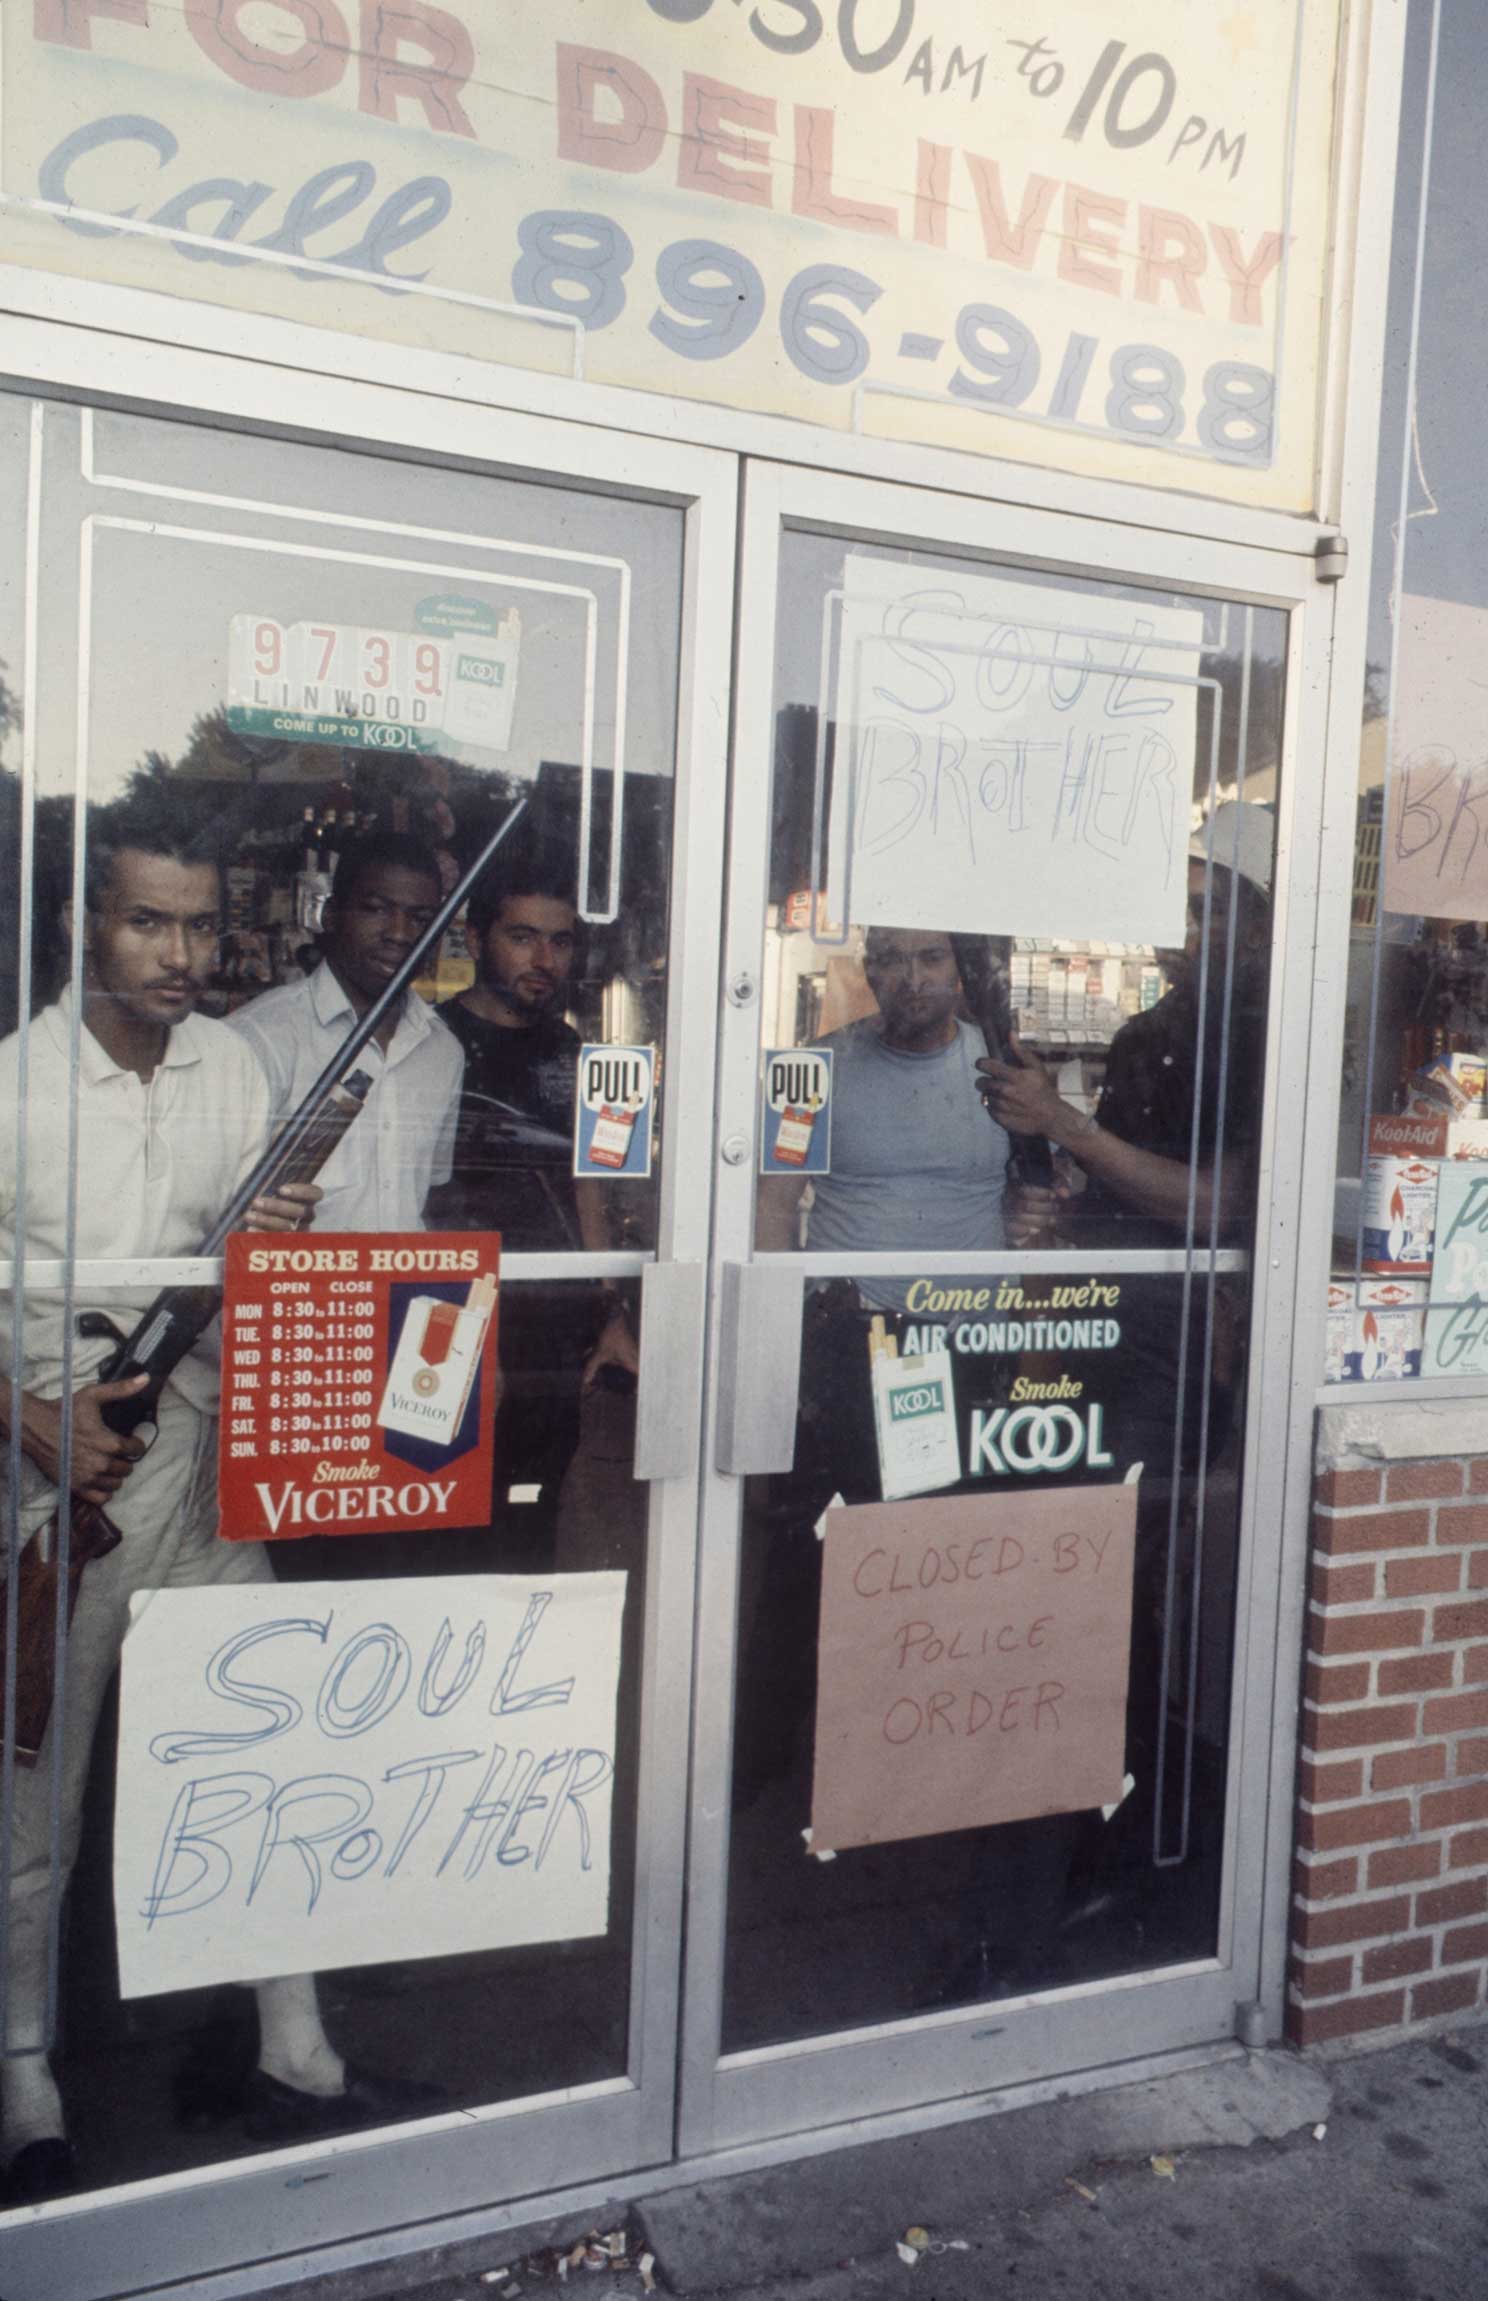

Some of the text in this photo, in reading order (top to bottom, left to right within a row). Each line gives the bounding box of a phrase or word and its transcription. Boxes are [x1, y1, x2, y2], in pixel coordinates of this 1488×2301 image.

[902, 35, 988, 103] AM
[1006, 35, 1065, 99] to
[1062, 39, 1177, 149] 10
[1168, 115, 1248, 182] PM
[555, 41, 1297, 327] DELIVERY
[38, 114, 1276, 456] Call 896-9188
[255, 623, 442, 697] 9739
[872, 588, 1175, 718] SOUL
[460, 660, 503, 683] KOOL
[254, 680, 427, 723] LINWOOD
[273, 717, 417, 749] COME UP TO KOOL
[249, 1248, 479, 1273] STORE HOURS
[270, 1281, 374, 1295] OPEN CLOSE
[905, 1279, 991, 1313] Come
[235, 1304, 262, 1320] MON
[272, 1302, 314, 1318] 8:30
[326, 1301, 375, 1317] 11:00
[235, 1327, 261, 1343] TUE.
[271, 1324, 314, 1341] 8:30
[326, 1324, 374, 1339] 11:00
[903, 1319, 1121, 1355] AIR CONDITIONED
[233, 1350, 261, 1366] WED
[271, 1347, 313, 1363] 8:30
[325, 1347, 374, 1362] 11:00
[233, 1373, 261, 1389] THU.
[270, 1369, 312, 1387] 8:30
[325, 1369, 373, 1385] 11:00
[1009, 1374, 1083, 1401] Smoke
[231, 1395, 255, 1412] FRI.
[269, 1392, 311, 1409] 8:30
[324, 1391, 373, 1407] 11:00
[390, 1391, 451, 1423] VICEROY
[893, 1386, 941, 1416] KOOL
[231, 1418, 257, 1435] SAT.
[269, 1415, 311, 1432] 8:30
[323, 1414, 371, 1430] 11:00
[969, 1403, 1115, 1476] KOOL
[231, 1441, 258, 1458] SUN.
[269, 1438, 311, 1455] 8:30
[322, 1436, 370, 1452] 10:00
[312, 1458, 381, 1485] Smoke
[255, 1480, 458, 1534] VICEROY
[853, 1529, 1113, 1598] CLOSED BY
[149, 1591, 576, 1765] SOUL
[882, 1681, 1065, 1745] ORDER
